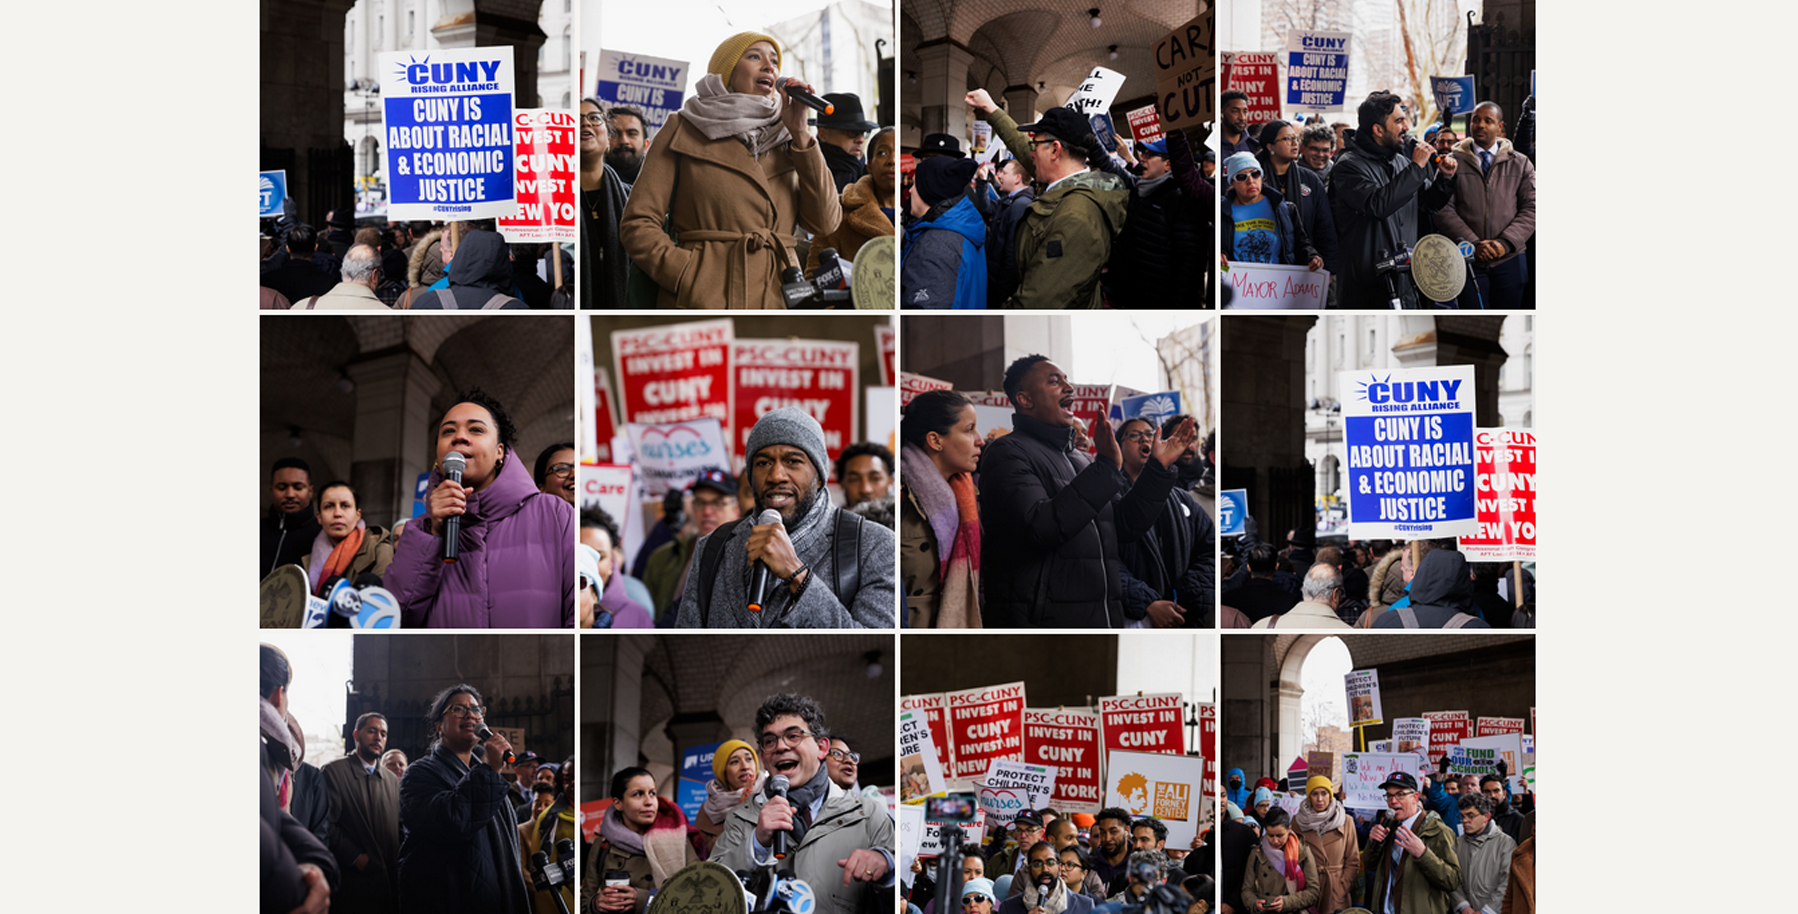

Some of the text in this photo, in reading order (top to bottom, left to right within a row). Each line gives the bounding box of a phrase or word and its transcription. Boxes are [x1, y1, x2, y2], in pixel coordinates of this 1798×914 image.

[1302, 36, 1345, 48] CUNY
[1235, 54, 1274, 64] -CUNY
[1303, 53, 1336, 66] CUNY IS
[407, 60, 501, 85] CUNY
[617, 60, 681, 82] CUNY
[1177, 66, 1203, 88] NOT
[1259, 66, 1273, 75] IN
[1289, 65, 1346, 80] ABOUT RACIAL
[411, 83, 499, 93] RISING ALLIANCE
[1291, 79, 1343, 92] & ECONOMIC
[616, 83, 652, 104] CUNY
[651, 87, 665, 107] IS
[1261, 96, 1273, 106] IN
[1300, 92, 1334, 105] JUSTICE
[1439, 94, 1462, 107] UFT
[413, 97, 482, 122] CUNY IS
[516, 112, 575, 126] C-CUN
[389, 123, 511, 149] ABOUT RACIAL
[398, 150, 504, 175] & ECONOMIC
[418, 177, 485, 202] JUSTICE
[516, 178, 566, 194] NVEST
[546, 202, 575, 221] YO
[619, 328, 727, 352] PSC-CUNY
[627, 347, 723, 375] INVEST IN
[735, 344, 851, 365] PSC-CUNY
[740, 367, 845, 391] INVEST IN
[643, 375, 713, 405] CUNY
[1368, 379, 1462, 404] CUNY
[1372, 402, 1460, 412] RISING ALLIANCE
[1374, 416, 1443, 441] CUNY IS
[1477, 431, 1536, 445] C-CUN
[641, 441, 711, 459] nurses
[1350, 442, 1472, 468] ABOUT RACIAL
[585, 478, 625, 495] Care
[1359, 469, 1465, 494] & ECONOMIC
[1379, 496, 1446, 521] JUSTICE
[1477, 497, 1527, 513] NVEST
[1507, 521, 1536, 540] YO
[950, 686, 1021, 706] PSC-CUNY
[1103, 696, 1180, 711] PSC-CUNY
[901, 696, 941, 713] CUNY
[956, 701, 1018, 720] INVEST IN
[1024, 711, 1096, 727] PSC-CUNY
[1108, 711, 1175, 726] INVEST IN
[1430, 721, 1464, 730] NVEST IN
[1479, 718, 1522, 729] PSC-CUNY
[967, 719, 1011, 740] CUNY
[1029, 726, 1092, 741] INVEST IN
[1431, 732, 1460, 742] CUNY
[1481, 727, 1507, 735] INVEST
[961, 736, 1020, 755] INVEST IN
[1119, 730, 1167, 747] CUNY
[1038, 745, 1084, 762] CUNY
[1451, 756, 1472, 766] OUR
[1466, 747, 1494, 759] FUND
[957, 758, 987, 775] NEW
[1077, 768, 1091, 779] IN
[1310, 766, 1329, 774] NOT
[1451, 764, 1496, 774] SCHOOLS
[996, 769, 1046, 783] PROTECT
[1059, 783, 1098, 800] YORK
[1165, 784, 1188, 800] ALI
[981, 796, 1023, 809] nurses
[1155, 799, 1187, 808] FORNEY
[1154, 807, 1186, 818] CENTER
[926, 827, 940, 838] Fo
[922, 841, 938, 849] ew
